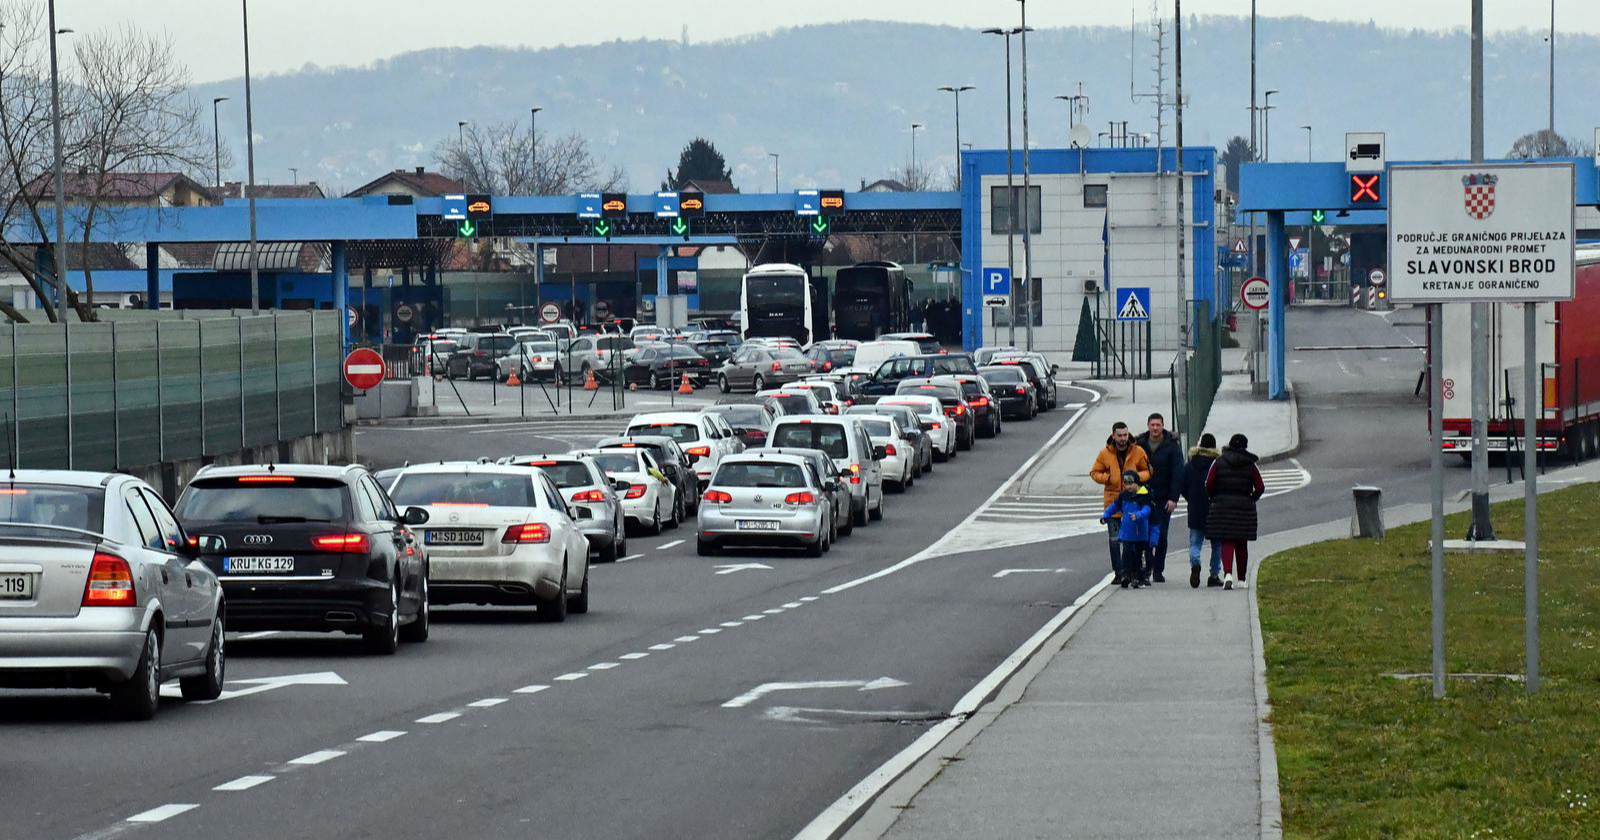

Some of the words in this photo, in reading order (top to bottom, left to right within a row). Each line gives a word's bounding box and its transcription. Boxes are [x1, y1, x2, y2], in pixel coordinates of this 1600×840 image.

[1396, 231, 1448, 243] PODRUČJE
[1451, 231, 1507, 242] GRANIČNOG
[1510, 231, 1566, 241] PRIJELAZA
[1416, 246, 1429, 254] ZA
[1505, 244, 1546, 253] PROMET
[1407, 259, 1503, 275] SLAVONSKI
[1509, 258, 1556, 274] BROD
[990, 272, 1003, 290] P
[1422, 281, 1474, 291] KRETANJE
[1478, 278, 1540, 289] OGRANIČENO
[431, 530, 438, 541] M
[444, 530, 456, 541] SD
[459, 530, 482, 541] 1064
[230, 558, 251, 569] KRU
[257, 558, 272, 569] KG
[273, 558, 293, 569] 129
